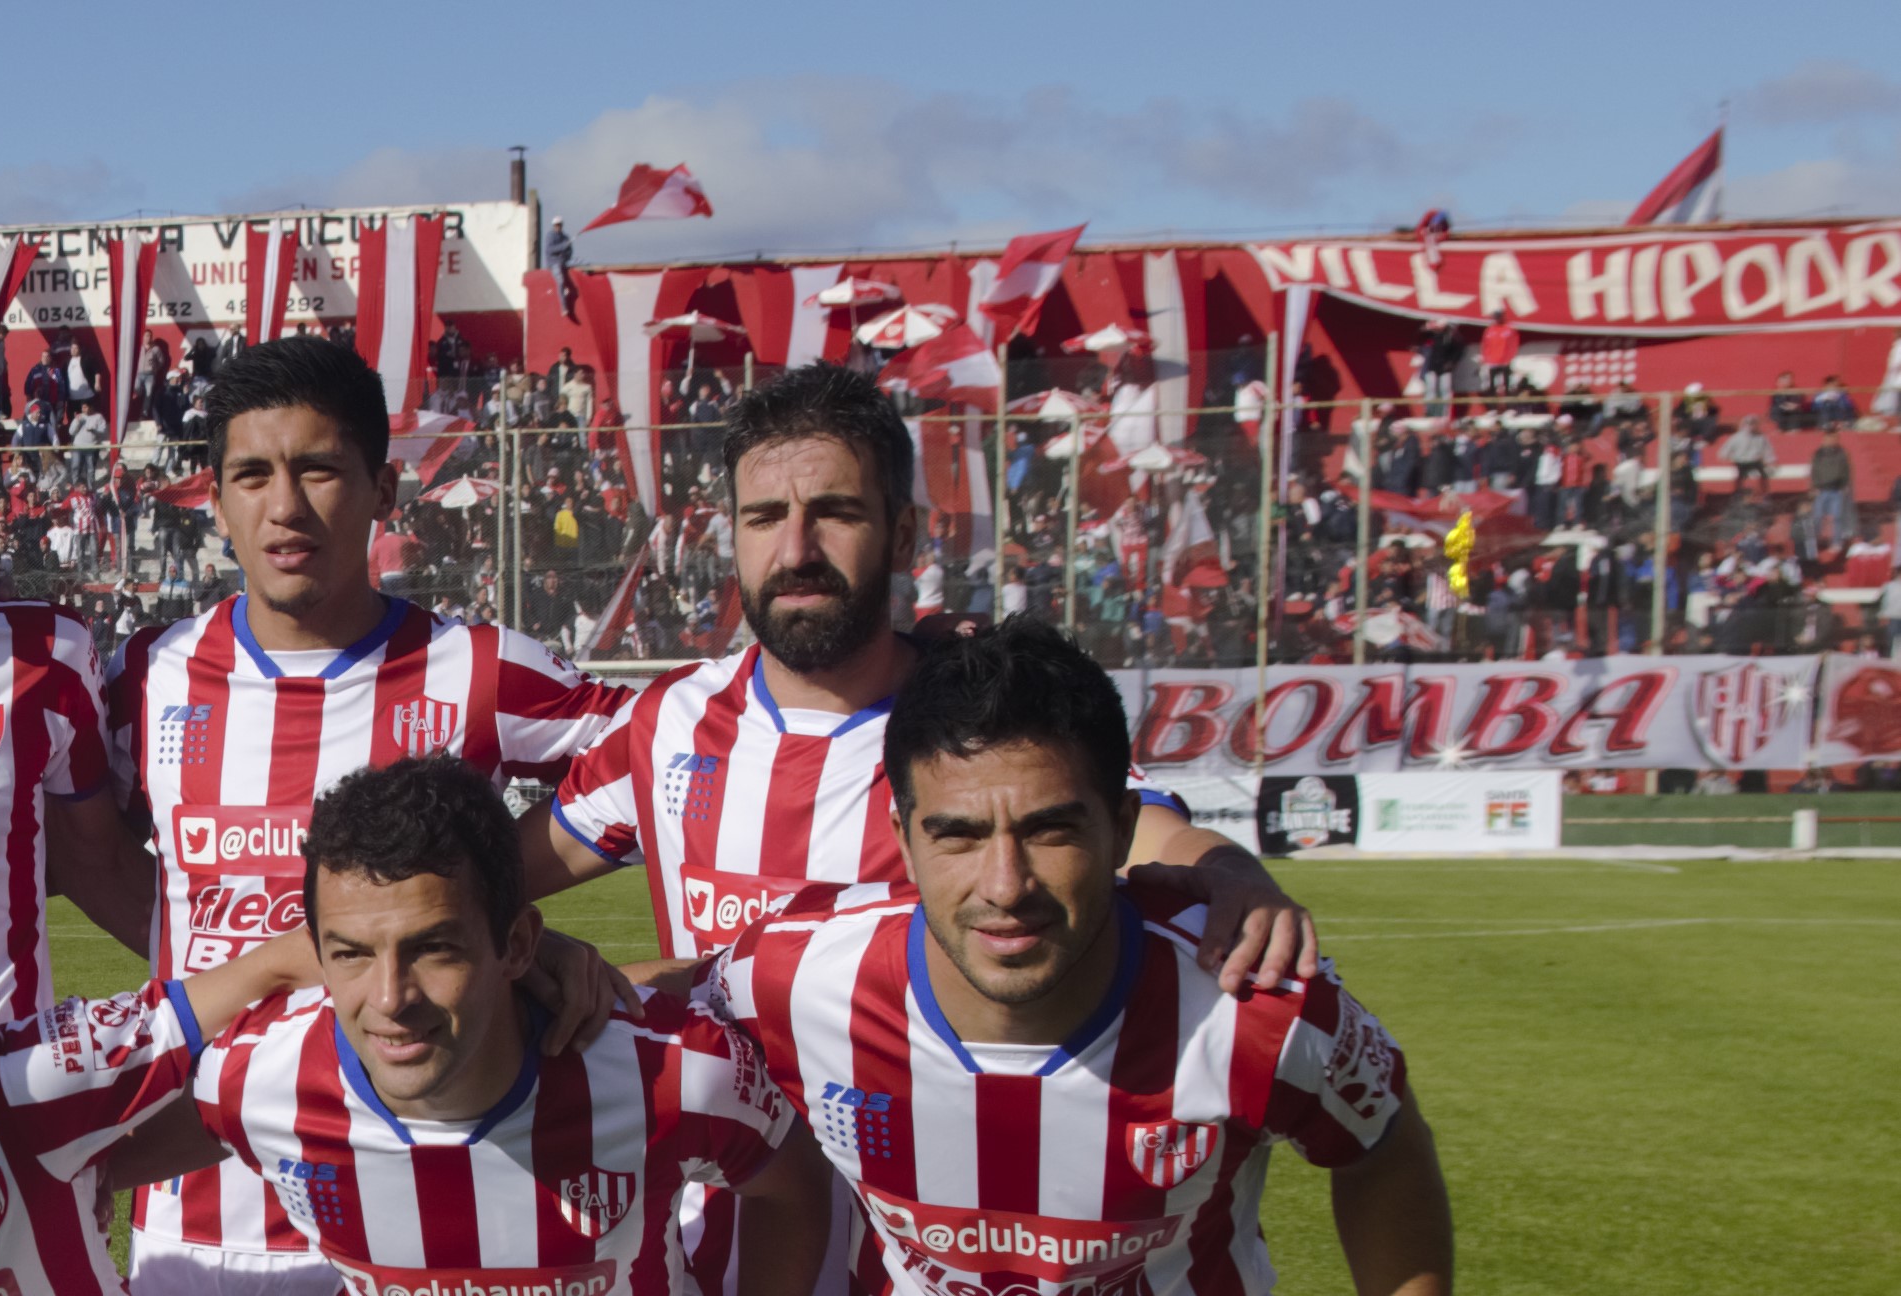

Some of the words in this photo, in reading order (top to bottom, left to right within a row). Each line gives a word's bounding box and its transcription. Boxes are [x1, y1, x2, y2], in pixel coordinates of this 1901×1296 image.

[1257, 243, 1539, 318] VILLA
[399, 707, 446, 747] CAU
[1130, 666, 1679, 767] BOMBA
[1485, 802, 1531, 829] FE
[190, 885, 306, 935] flec
[823, 1081, 894, 1113] TBS
[1142, 1132, 1199, 1171] CAU
[567, 1180, 624, 1222] CAU
[922, 1219, 1165, 1271] @clubaunion
